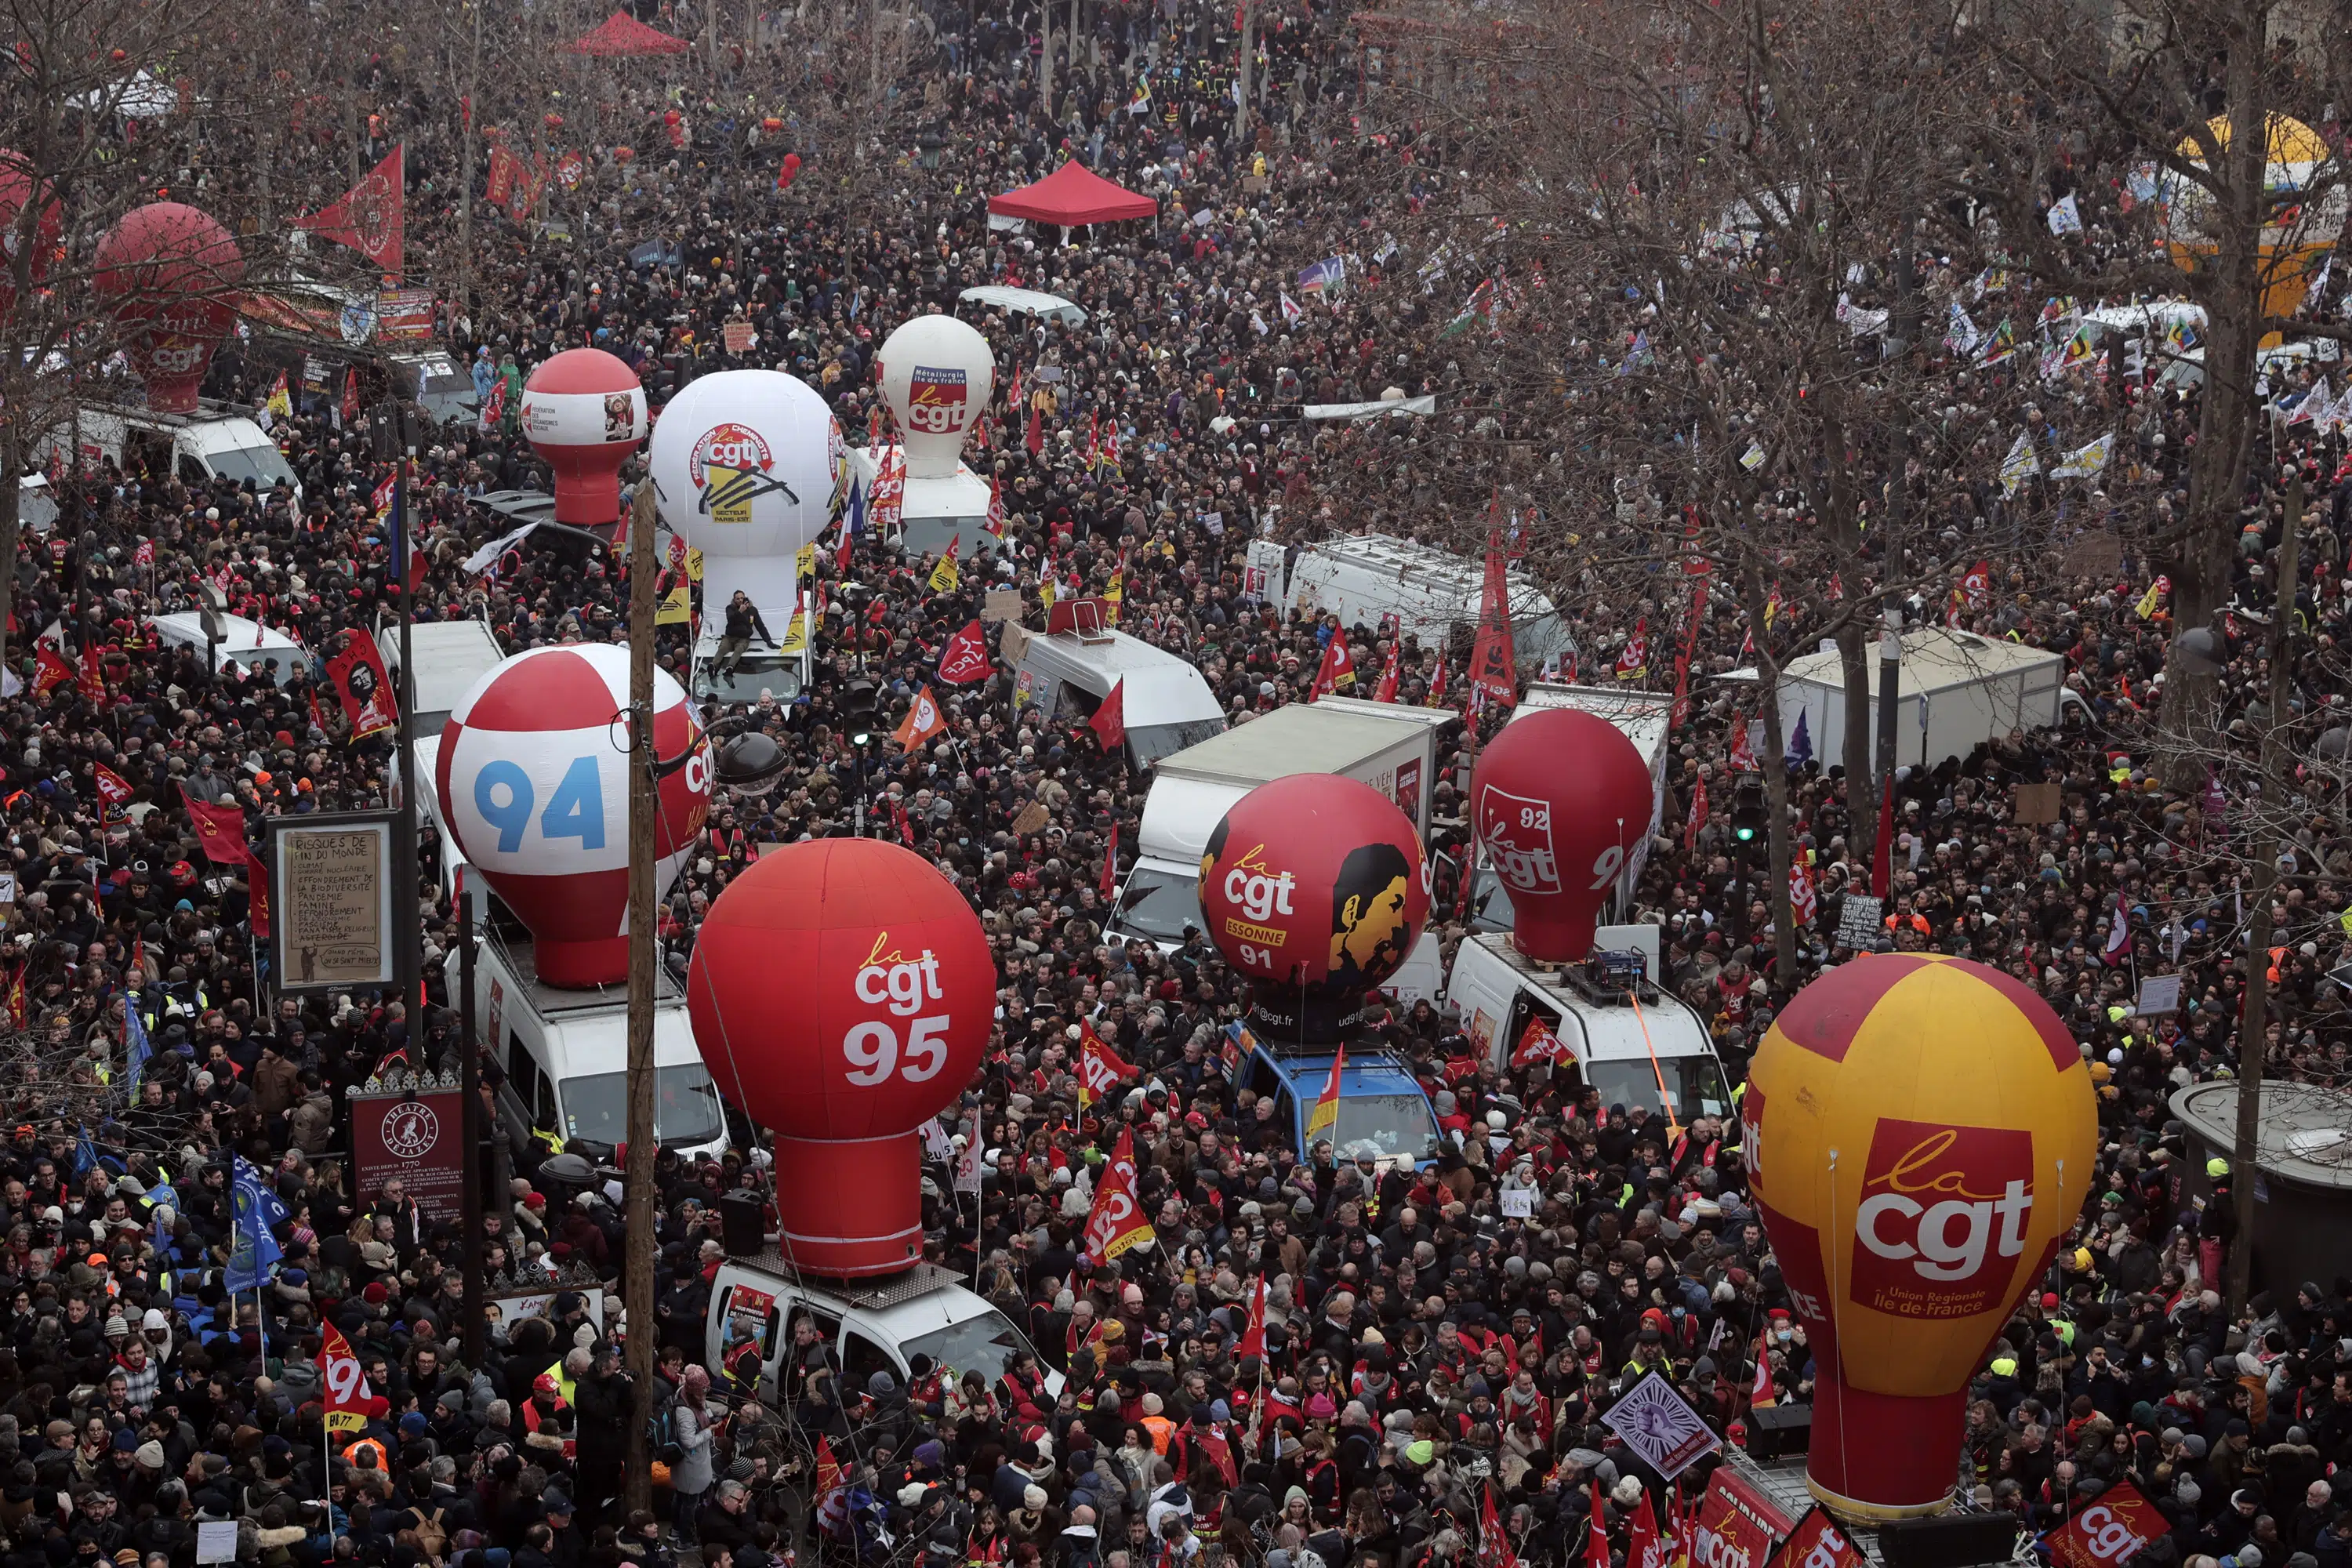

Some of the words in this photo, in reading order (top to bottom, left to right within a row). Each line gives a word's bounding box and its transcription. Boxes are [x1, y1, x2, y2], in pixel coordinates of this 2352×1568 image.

[153, 343, 204, 372] cgt
[915, 369, 964, 379] Métallurgie
[913, 385, 965, 406] la
[909, 400, 966, 432] cgt
[712, 426, 745, 444] la
[691, 429, 717, 480] FÉDÉRATION
[731, 424, 768, 460] CHEMINOTS
[709, 438, 753, 466] cgt
[474, 755, 605, 852] 94
[1520, 808, 1549, 831] 92
[296, 837, 345, 850] RISQUES
[352, 837, 366, 847] DE
[1486, 822, 1552, 855] la
[294, 851, 311, 861] FIN
[316, 850, 328, 860] DU
[332, 848, 368, 859] MONDE
[1233, 844, 1295, 879] la
[1486, 843, 1559, 888] cgt
[298, 875, 361, 884] EFFONDREMENT
[327, 865, 367, 874] NUCLÉAIRE
[311, 882, 370, 892] BIODIVERSITÉ
[1225, 869, 1295, 921] cgt
[298, 907, 364, 917] EFFONDREMENT
[1846, 897, 1879, 906] CITOYENS
[1227, 920, 1283, 944] ESSONNE
[858, 931, 936, 970] la
[1240, 944, 1272, 969] 91
[855, 949, 943, 1016] cgt
[844, 1014, 949, 1087] 95
[385, 1104, 434, 1126] THÉÂTRE
[387, 1134, 434, 1156] DÉJAZET
[401, 1160, 419, 1169] 1770
[1867, 1129, 2034, 1199] la
[1856, 1179, 2034, 1281] cgt
[519, 1299, 546, 1311] KAME
[1874, 1289, 1895, 1311] Île
[1889, 1287, 1923, 1301] Union
[1927, 1288, 1986, 1303] Régionale
[746, 1308, 764, 1316] PROFITER
[2103, 1500, 2149, 1544] la
[2081, 1506, 2147, 1565] cgt
